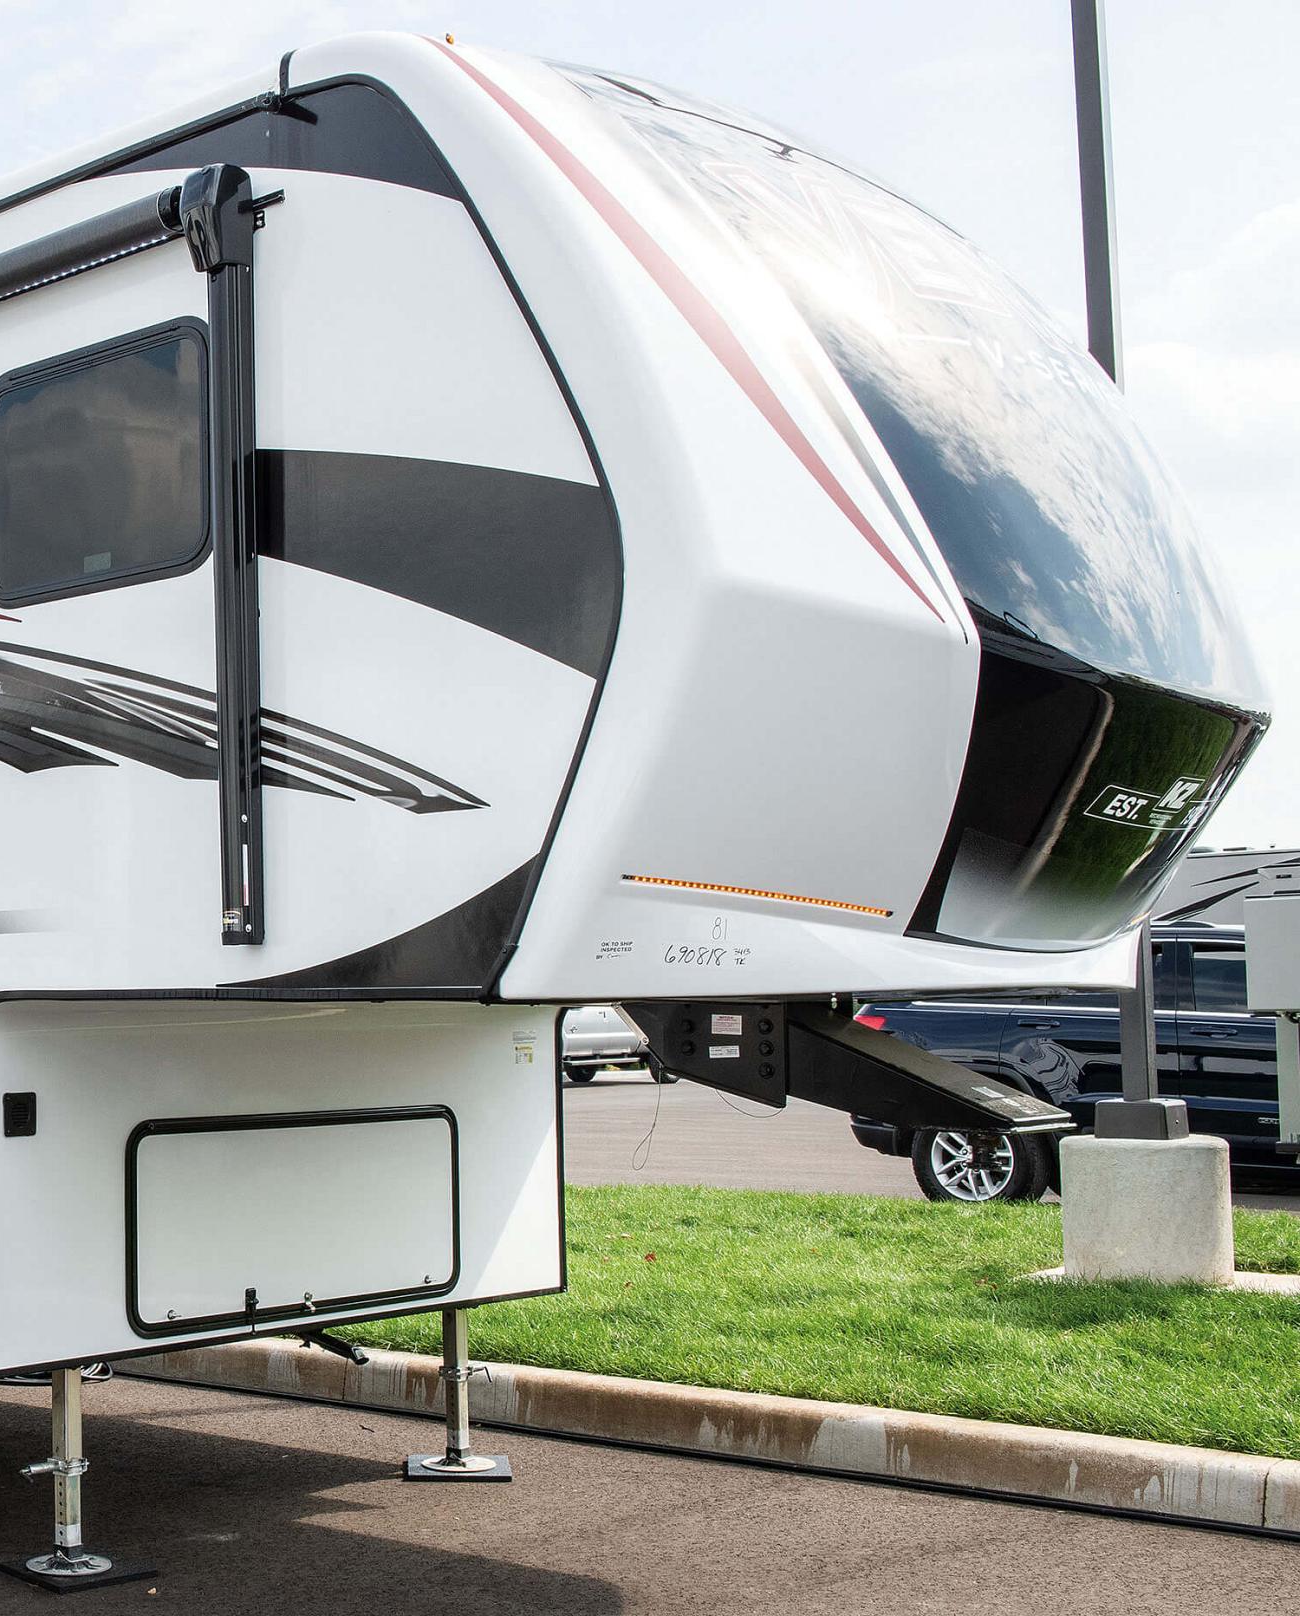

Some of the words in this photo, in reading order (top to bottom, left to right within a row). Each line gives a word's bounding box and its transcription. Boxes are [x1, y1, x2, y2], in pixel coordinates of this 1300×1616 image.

[1103, 793, 1149, 820] EST.
[1158, 781, 1200, 809] KZ
[664, 944, 728, 966] 690818
